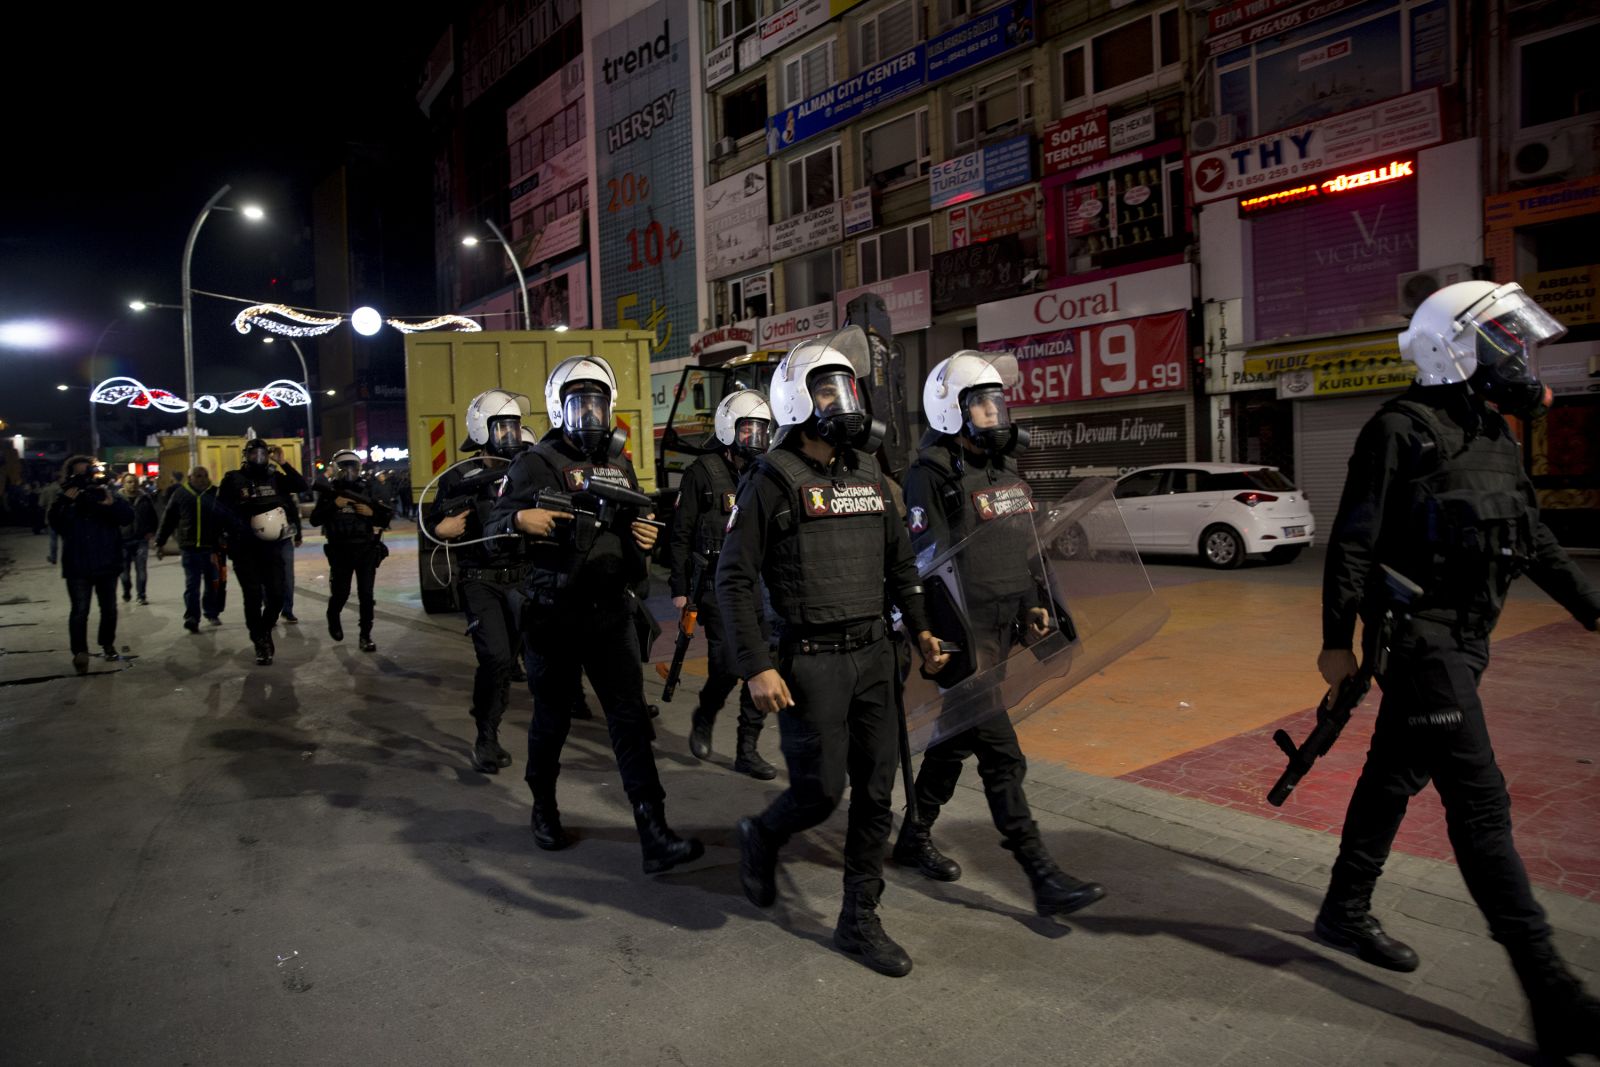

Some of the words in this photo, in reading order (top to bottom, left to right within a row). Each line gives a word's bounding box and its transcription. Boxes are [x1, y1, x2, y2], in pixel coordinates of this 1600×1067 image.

[1249, 11, 1301, 39] PEGASUS
[603, 19, 670, 84] trend
[798, 89, 835, 119] ALMAN
[837, 77, 864, 100] CITY
[866, 51, 917, 86] CENTER
[607, 88, 676, 154] HERŞEY
[1051, 120, 1099, 147] SOFYA
[1045, 136, 1107, 164] TERCÜME
[1231, 130, 1313, 174] THY
[1246, 174, 1265, 185] 850
[1302, 159, 1322, 171] 999
[1241, 185, 1319, 212] VICTORIA
[1321, 161, 1413, 193] GÜZELLİK
[1315, 233, 1416, 265] VICTORIA
[1538, 274, 1590, 289] ABBAS
[1034, 281, 1120, 324] Coral
[1266, 354, 1309, 371] YILDIZ
[1031, 363, 1073, 403] ŞEY
[553, 410, 561, 420] 34
[1075, 422, 1117, 445] Devam
[831, 496, 885, 513] OPERASYON
